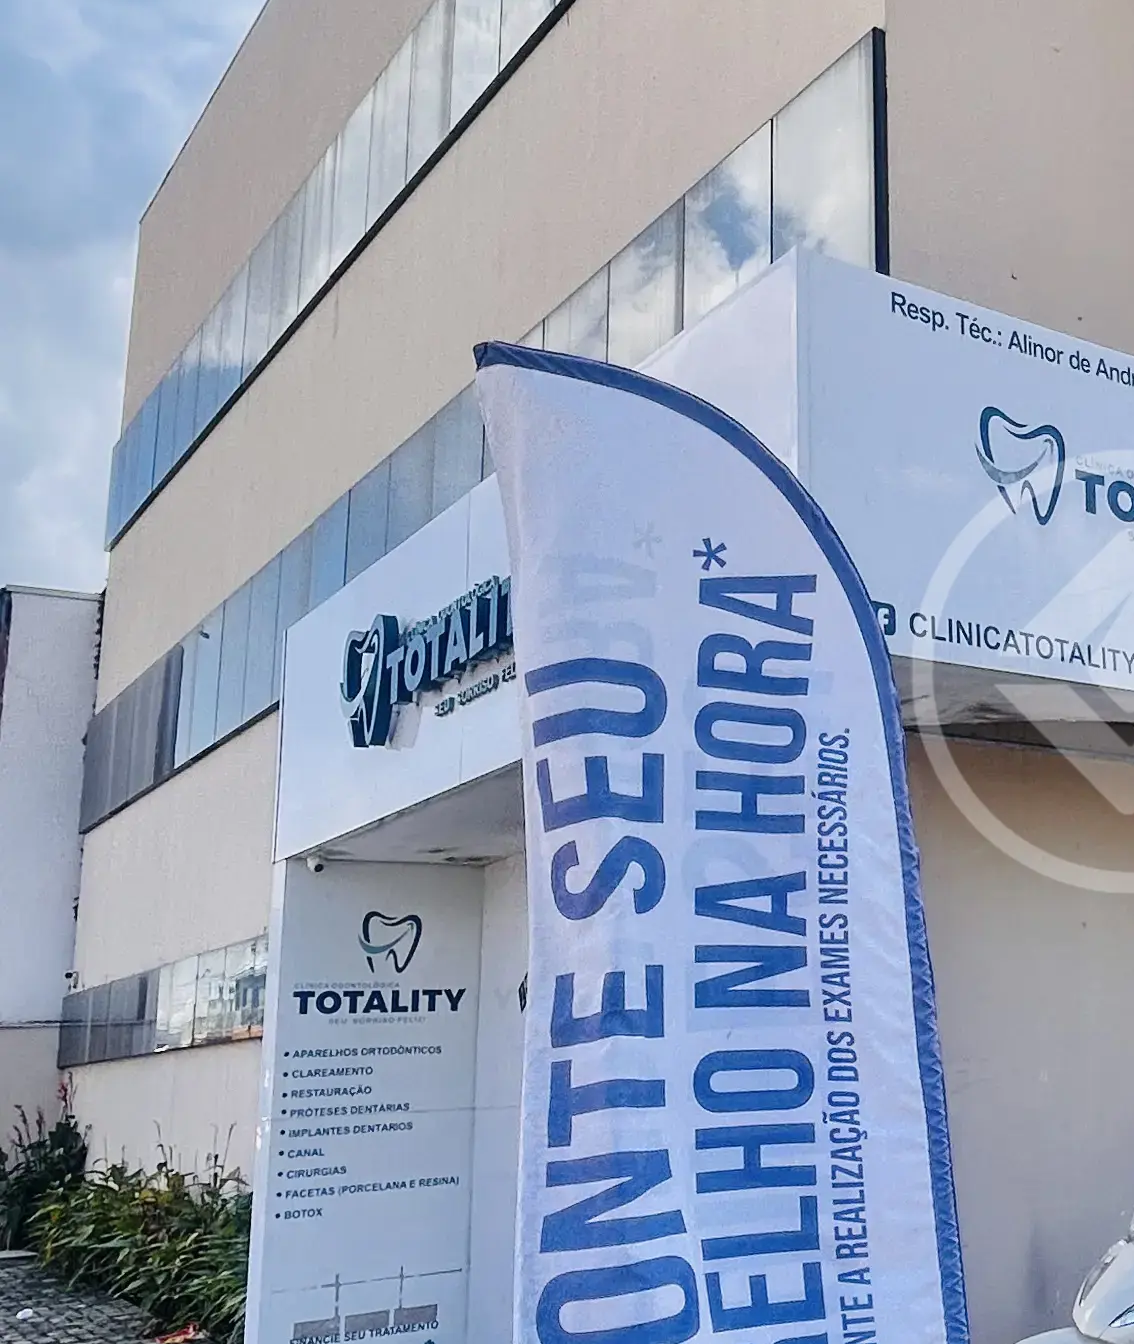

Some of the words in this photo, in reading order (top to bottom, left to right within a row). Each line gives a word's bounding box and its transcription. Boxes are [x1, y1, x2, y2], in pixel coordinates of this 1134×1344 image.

[891, 291, 949, 331] Resp.
[956, 312, 1002, 347] Téc.:
[1008, 330, 1064, 365] Alinor
[1069, 350, 1091, 373] de
[386, 575, 513, 705] TOTALIT
[525, 657, 668, 921] SEU
[810, 728, 850, 904] NECESSÁRIOS.
[692, 871, 811, 1009] NA
[819, 913, 852, 1023] EXAMES
[292, 987, 467, 1015] TOTALITY
[292, 1047, 358, 1059] APARELHOS
[827, 1030, 859, 1083] DOS
[292, 1066, 374, 1079] CLAREAMENTO
[290, 1084, 372, 1099] RESTAURAÇÃO
[288, 1126, 351, 1138] IMPLANTES
[287, 1147, 325, 1159] CANAL
[286, 1165, 347, 1180] CIRURGIAS
[822, 1091, 869, 1260] REALIZAÇÃO
[285, 1186, 335, 1200] FACETAS
[338, 1180, 407, 1197] (PORCELANA
[409, 1179, 416, 1189] E
[418, 1175, 459, 1188] RESINA)
[284, 1207, 323, 1220] BOTOX
[838, 1266, 872, 1287] A
[344, 1329, 366, 1342] SEU
[370, 1320, 439, 1338] TRATAMENTO
